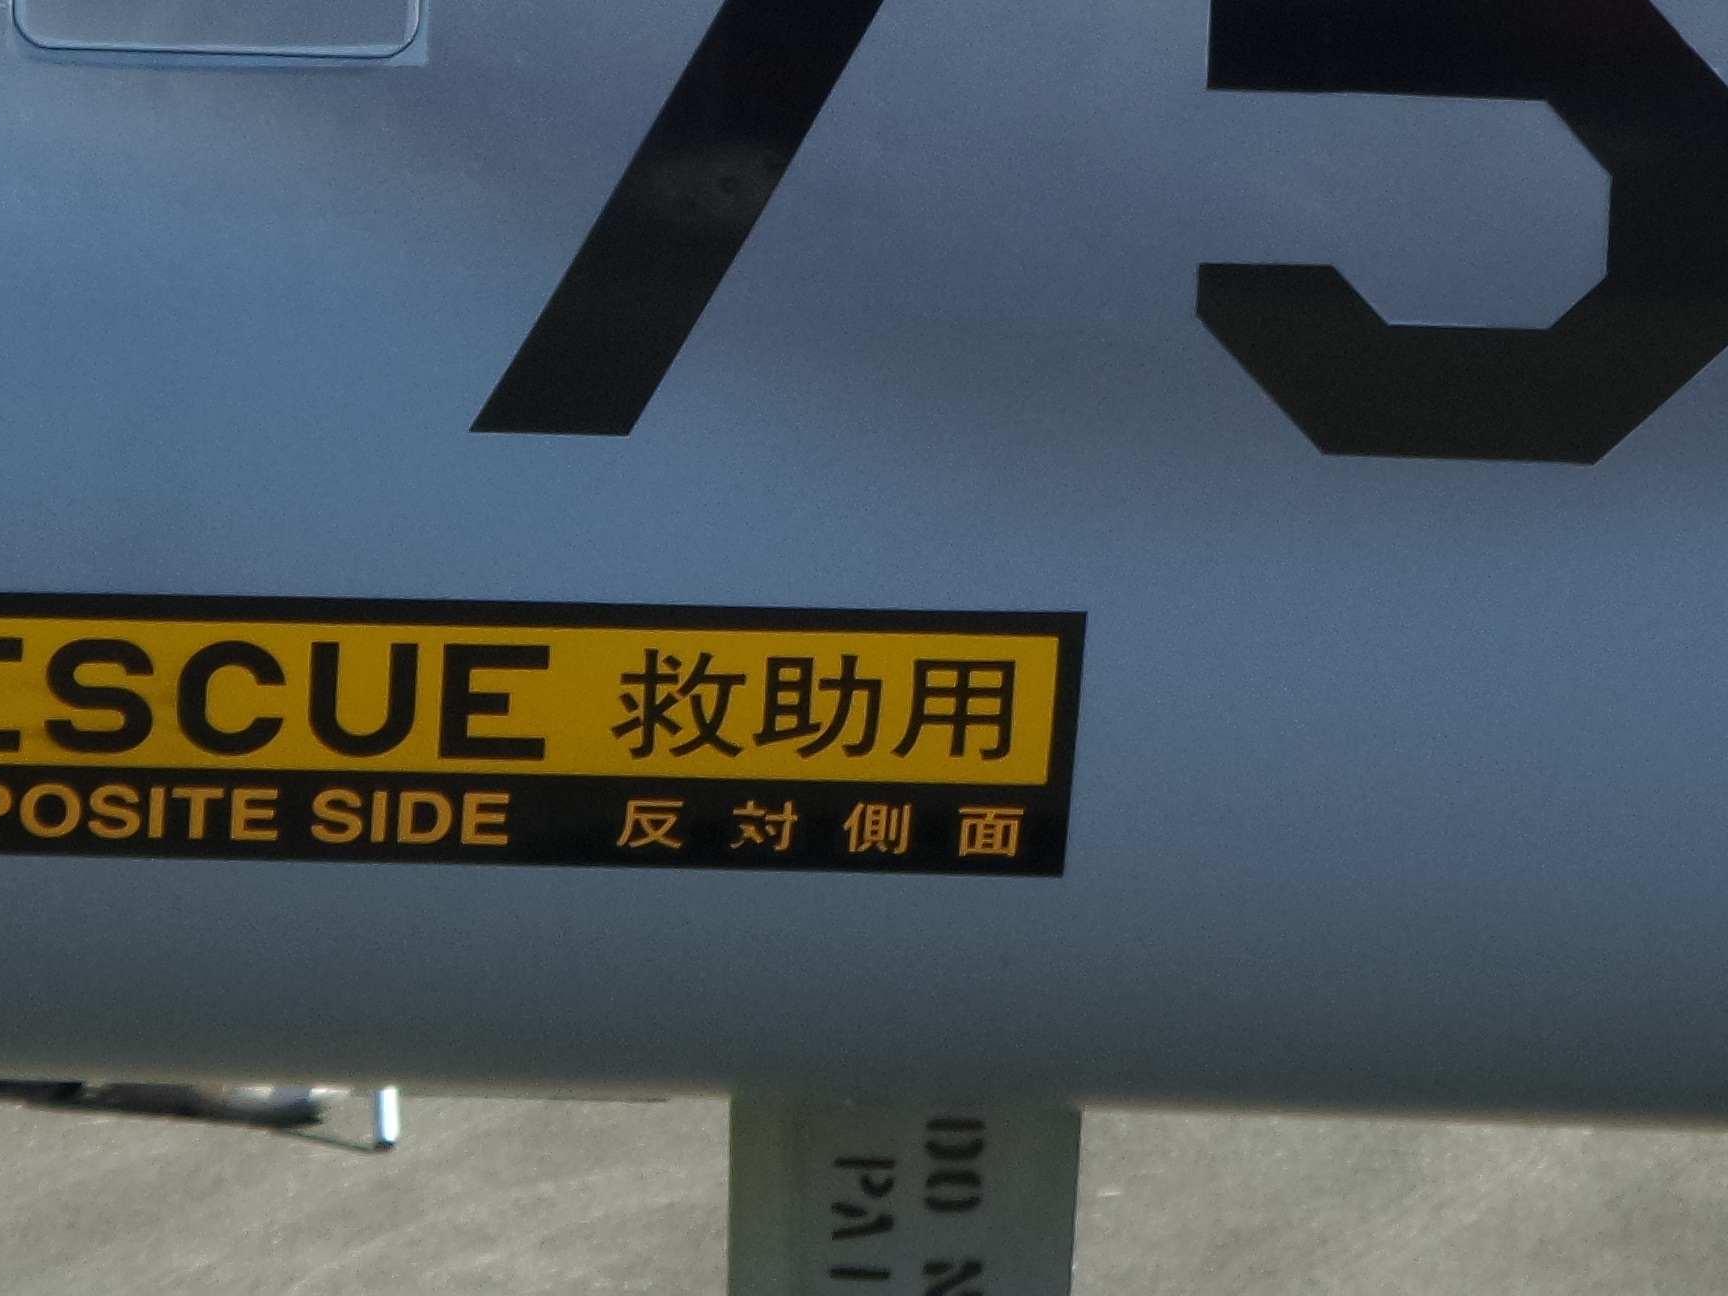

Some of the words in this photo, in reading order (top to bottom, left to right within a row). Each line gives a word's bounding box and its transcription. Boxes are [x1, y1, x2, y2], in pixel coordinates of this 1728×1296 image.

[610, 647, 1018, 761] 救助用
[310, 787, 511, 846] SIDE
[924, 1117, 986, 1212] DO
